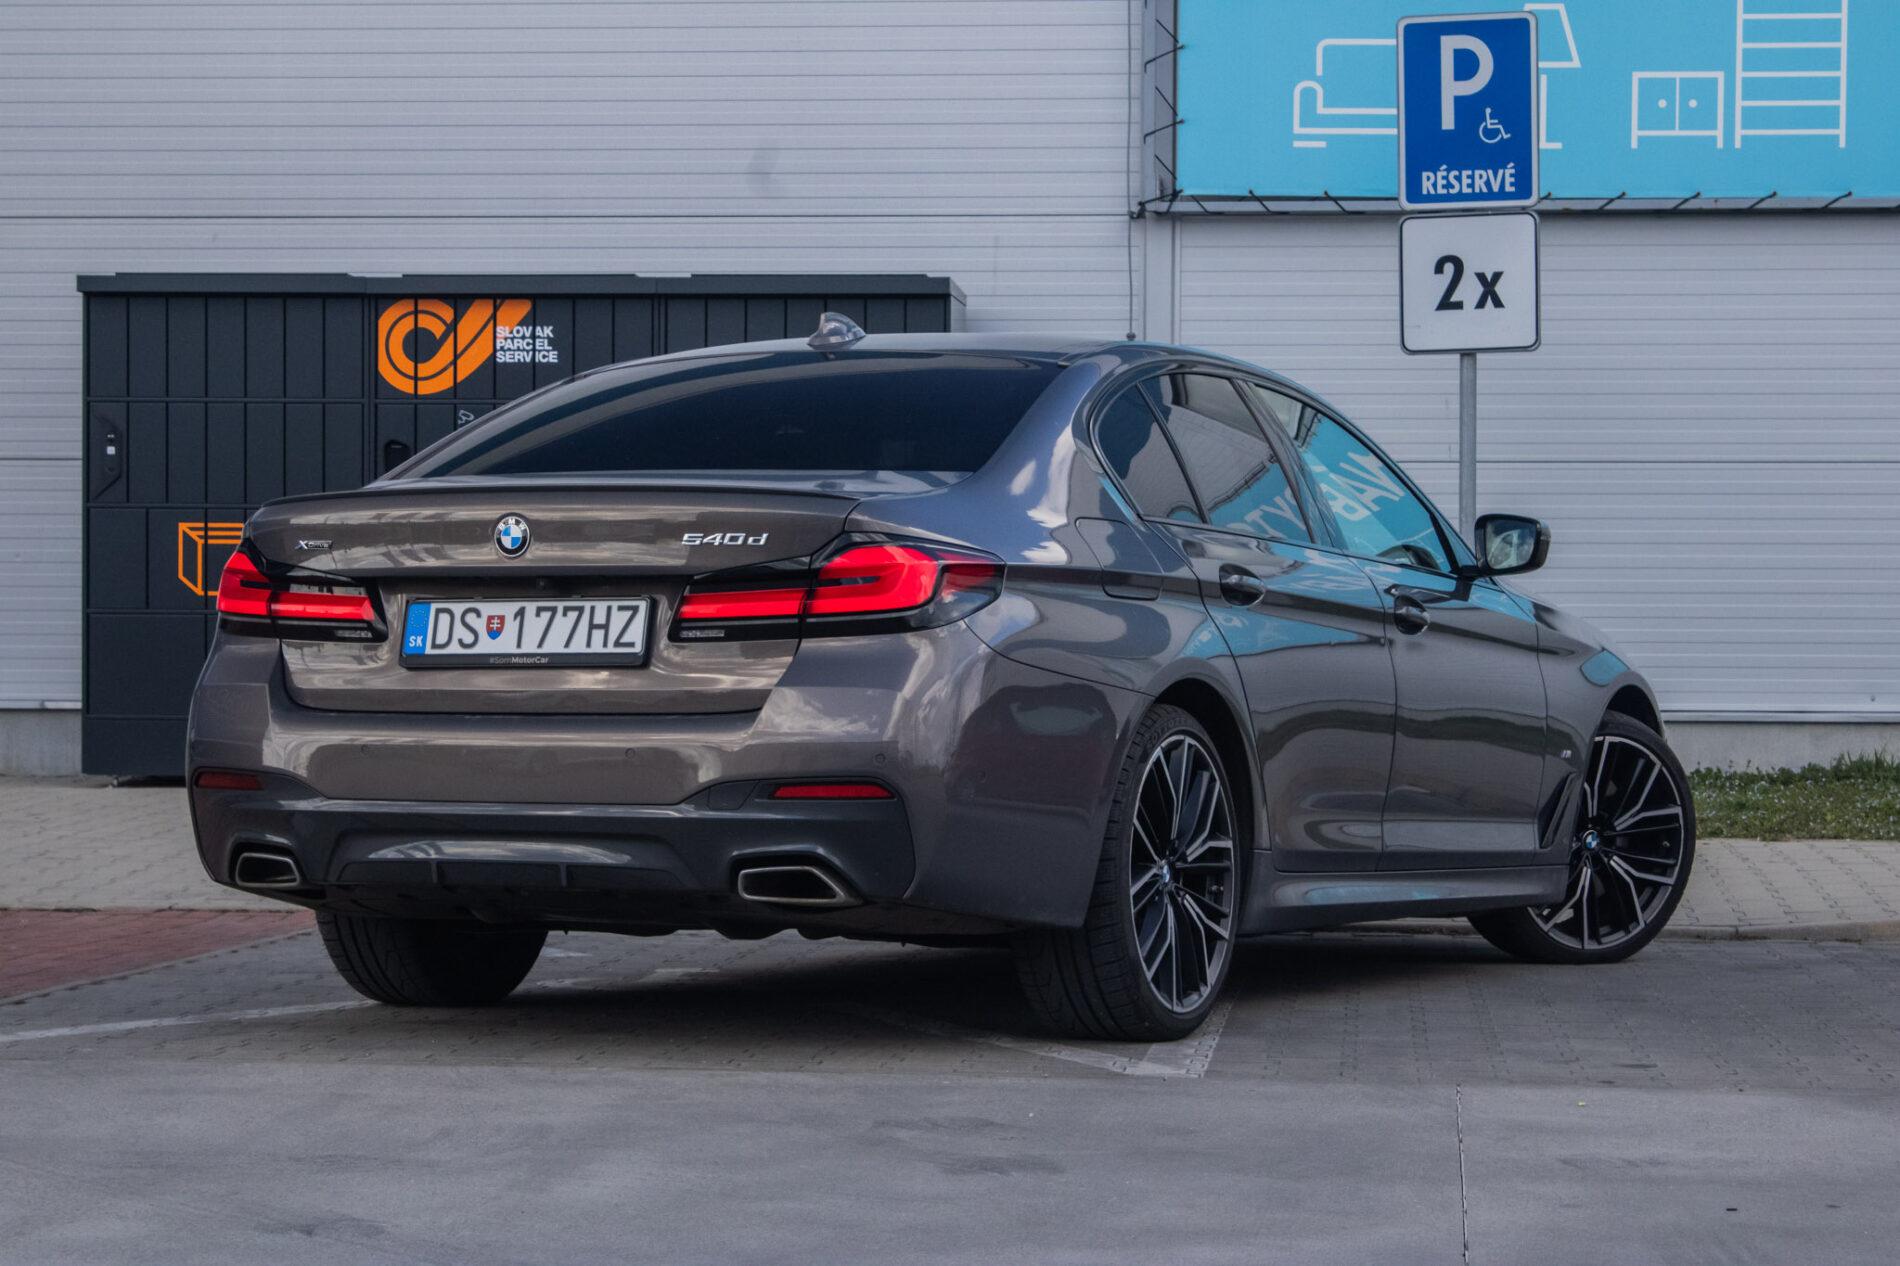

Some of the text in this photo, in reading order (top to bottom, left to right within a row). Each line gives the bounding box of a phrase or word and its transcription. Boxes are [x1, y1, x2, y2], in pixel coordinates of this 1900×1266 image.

[1440, 34, 1494, 130] P
[1421, 162, 1516, 195] RÉSERVÉ
[1434, 254, 1505, 312] 2x
[496, 325, 554, 338] SLOVAK
[496, 338, 552, 350] PARCEL
[496, 350, 558, 363] SERVICE
[681, 532, 769, 546] 540d
[430, 604, 641, 650] DS 177HZ
[408, 634, 424, 648] SK
